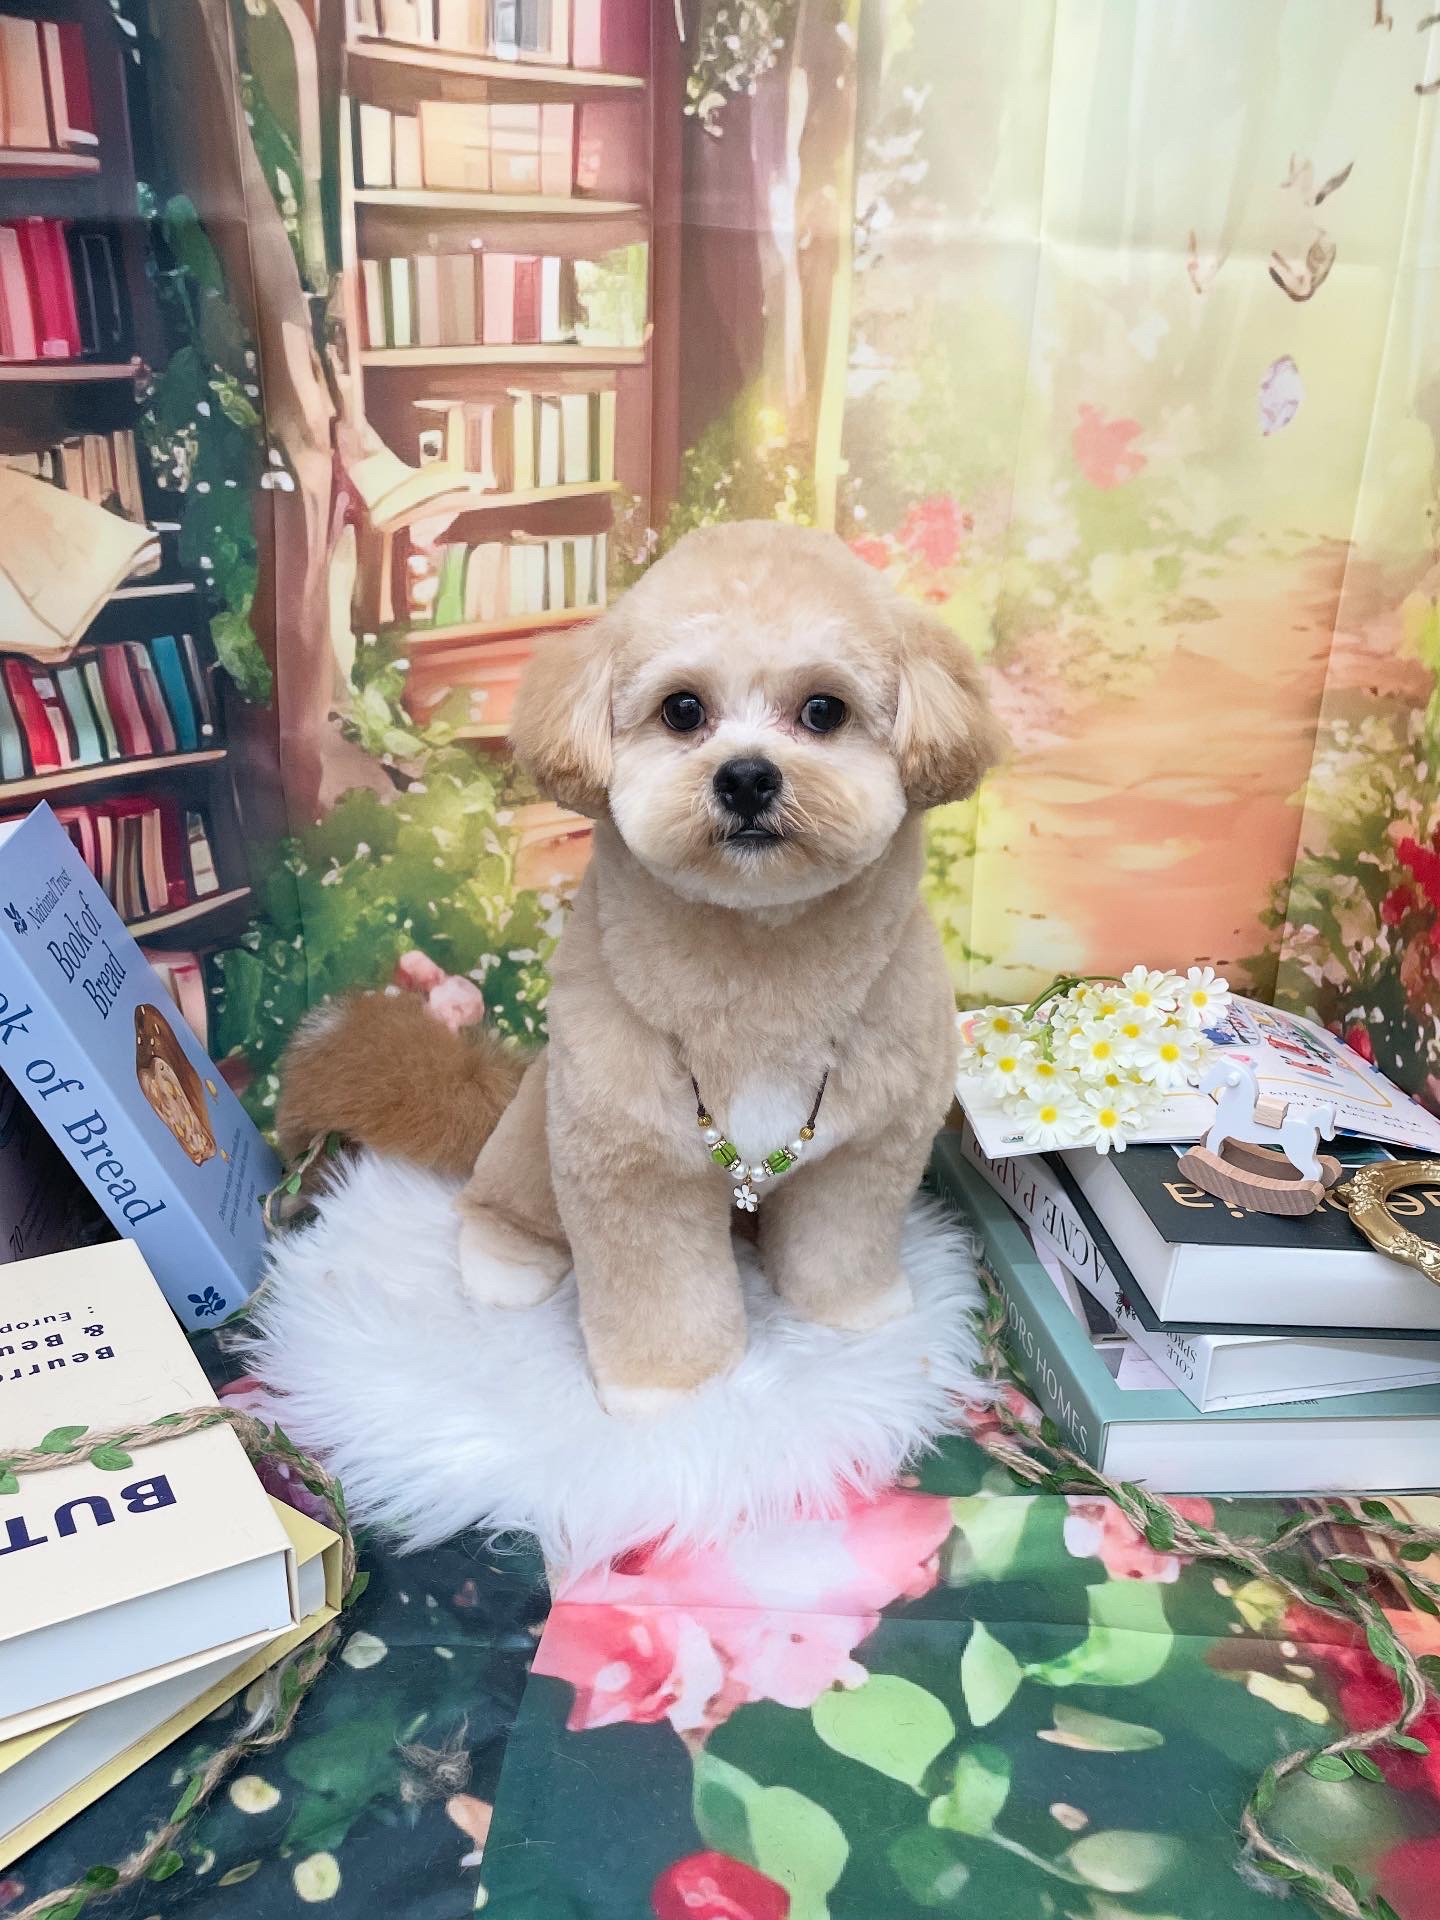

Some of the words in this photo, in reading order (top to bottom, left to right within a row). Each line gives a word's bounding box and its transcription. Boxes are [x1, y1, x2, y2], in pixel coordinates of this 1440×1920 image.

[27, 881, 60, 930] National
[50, 867, 72, 897] Trust
[47, 912, 93, 984] Book
[78, 889, 102, 937] of
[82, 939, 127, 1020] Bread
[26, 1059, 85, 1101] of
[62, 1109, 167, 1227] Bread
[1042, 1195, 1107, 1283] ACNE
[0, 1345, 115, 1384] Beurr
[81, 1324, 105, 1337] &
[1167, 1344, 1194, 1380] COLE
[1036, 1346, 1087, 1455] HOMES
[0, 1474, 177, 1557] BUT
